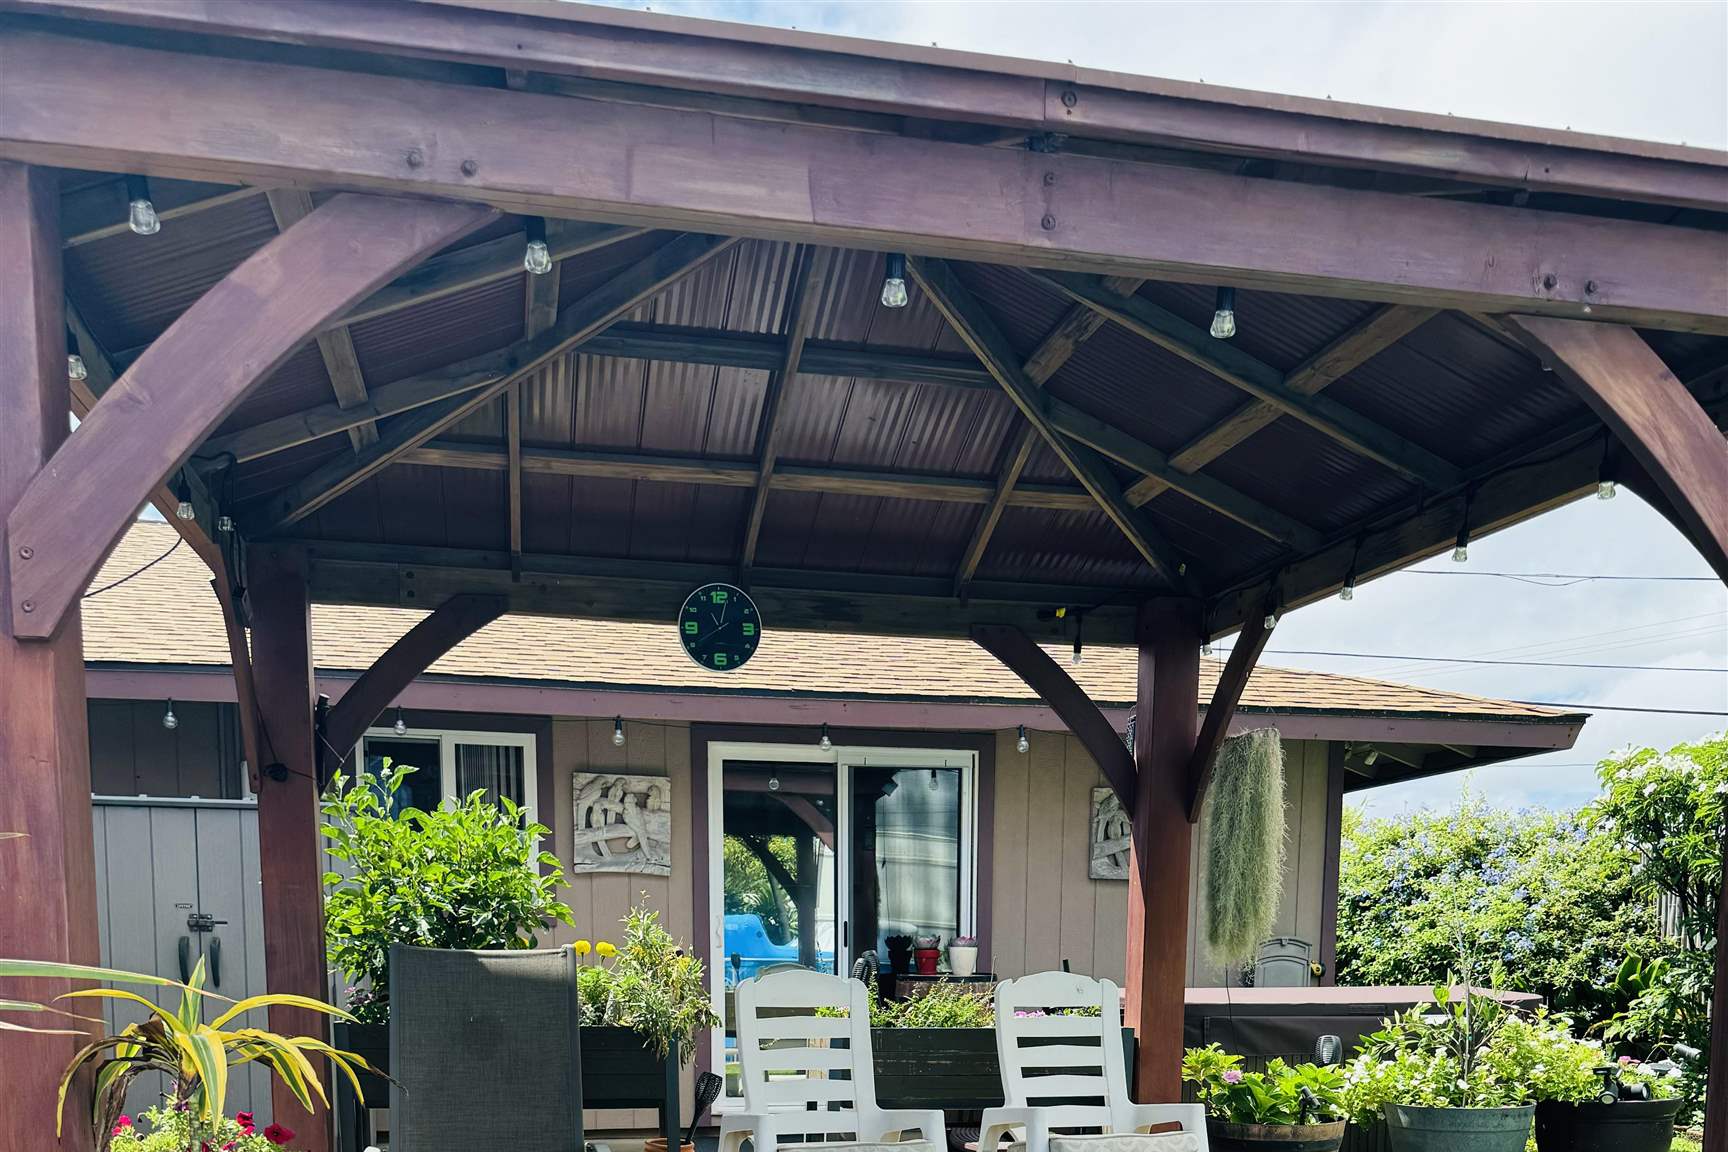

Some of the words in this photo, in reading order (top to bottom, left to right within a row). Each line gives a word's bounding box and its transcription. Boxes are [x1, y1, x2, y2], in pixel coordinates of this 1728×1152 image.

[711, 591, 728, 604] 12
[685, 621, 698, 635] 9
[742, 622, 755, 636] 3
[714, 653, 728, 666] 6
